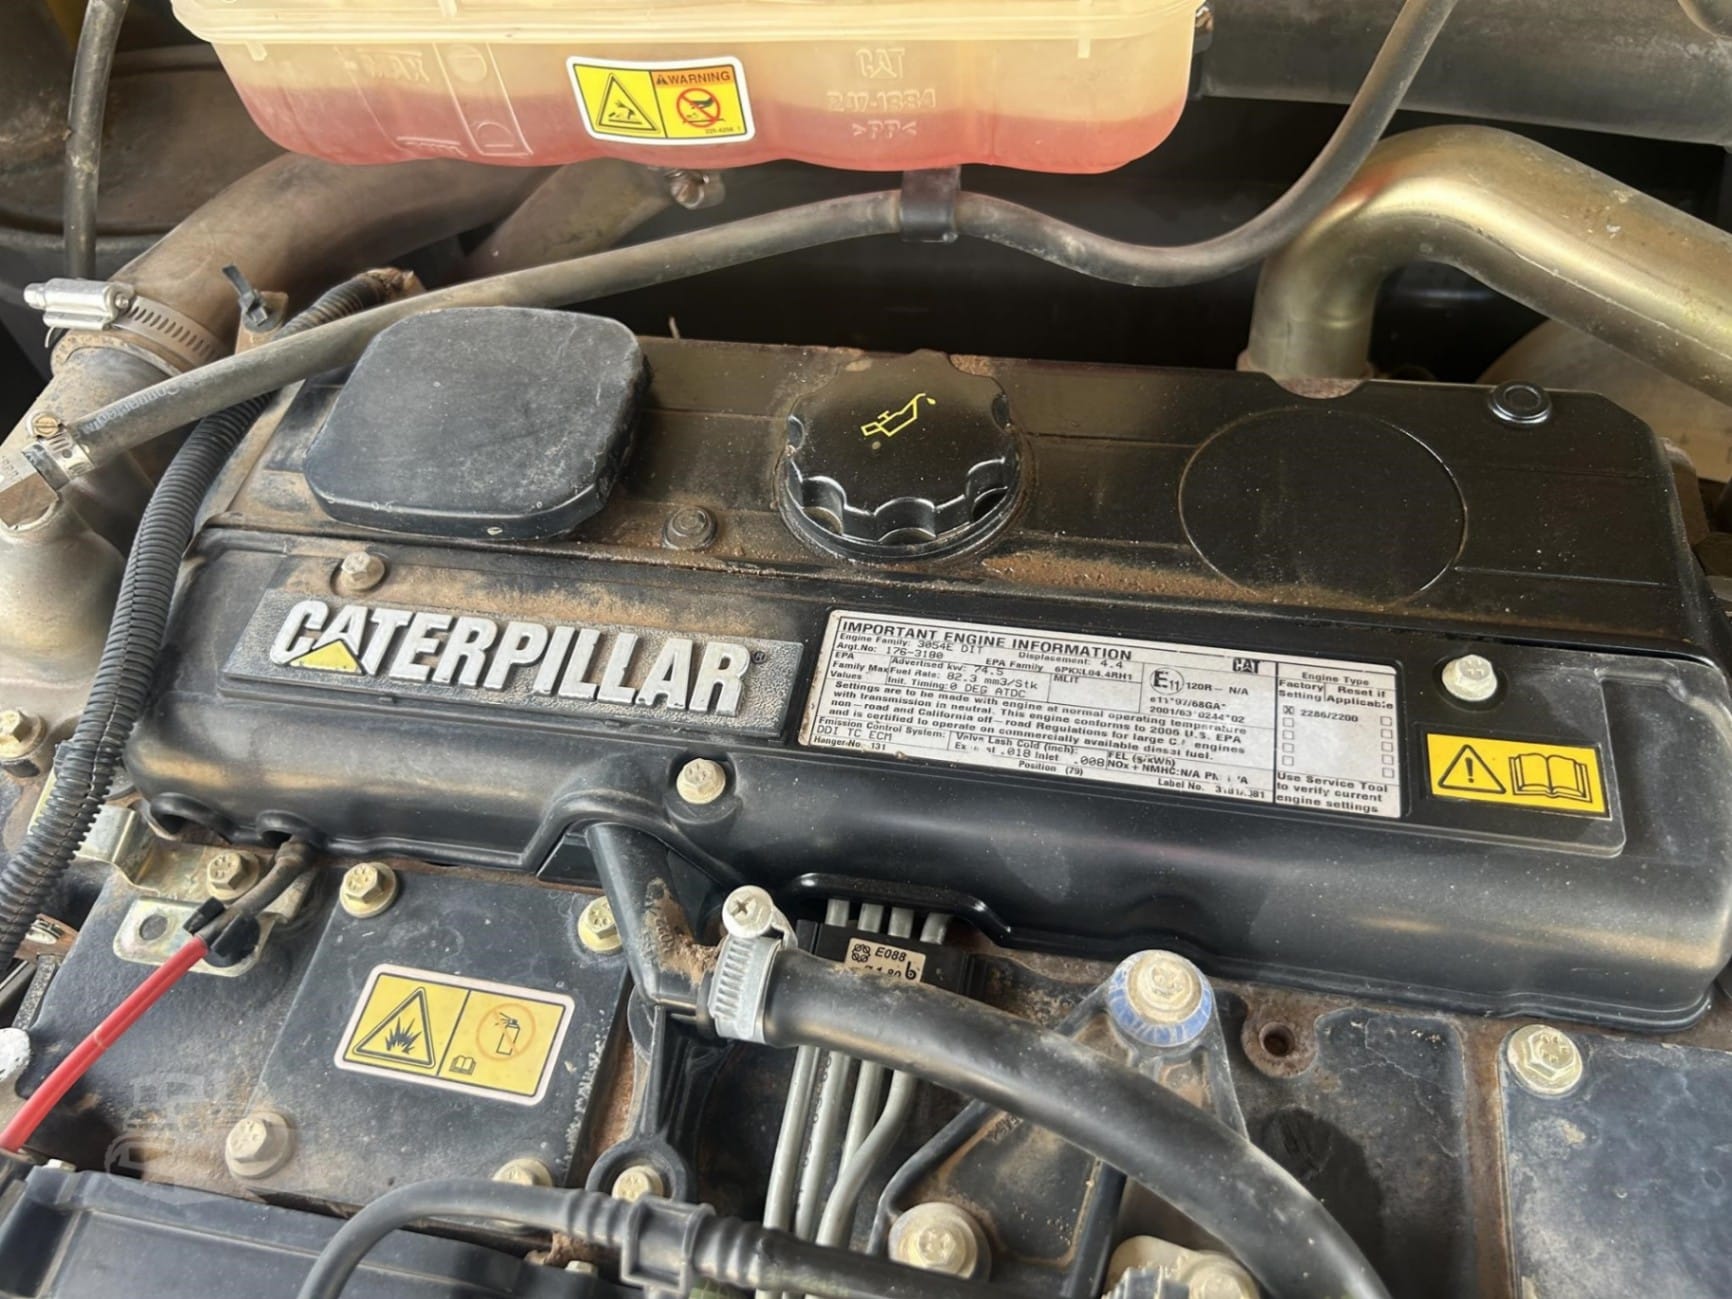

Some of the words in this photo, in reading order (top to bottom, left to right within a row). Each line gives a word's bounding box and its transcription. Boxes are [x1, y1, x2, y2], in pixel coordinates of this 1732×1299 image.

[667, 71, 731, 85] WARNING
[839, 632, 873, 643] Engine
[960, 644, 985, 655] DIT
[842, 621, 938, 641] IMPORTANT
[943, 631, 1006, 649] ENGINE
[1012, 638, 1132, 662] INFORMATION
[269, 600, 752, 717] CATERPILLAR
[834, 651, 854, 660] EPA
[891, 656, 944, 669] Advertised
[832, 660, 866, 672] Family
[867, 664, 889, 674] Max
[889, 666, 912, 676] Fuel
[985, 658, 1006, 667] EPA
[1009, 660, 1044, 673] Family
[1100, 659, 1123, 670] 4.4
[1232, 657, 1261, 674] CAT
[830, 670, 862, 680] Values
[1053, 674, 1080, 684] MLIT
[1301, 671, 1339, 683] Engine
[1343, 676, 1370, 687] Type
[1278, 679, 1325, 693] Factory
[1337, 685, 1373, 697] Reset
[1377, 690, 1386, 698] if
[1278, 689, 1322, 702] Setting
[835, 680, 880, 693] Settings
[883, 687, 902, 695] are
[905, 688, 917, 697] to
[920, 690, 934, 698] be
[938, 693, 970, 702] made
[974, 697, 998, 706] with
[1001, 700, 1043, 711] engine
[1047, 705, 1059, 713] at
[1061, 707, 1104, 718] normal
[1108, 713, 1166, 727] operating
[1170, 719, 1247, 735] temperature
[833, 690, 857, 699] with
[860, 692, 932, 708] transmission
[935, 701, 947, 709] in
[1000, 708, 1025, 718] This
[1029, 713, 1070, 724] engine
[1073, 718, 1131, 731] conforms
[1134, 724, 1146, 732] to
[1215, 733, 1242, 744] EPA
[866, 721, 903, 733] Control
[893, 706, 914, 715] and
[918, 708, 974, 722] California
[1035, 721, 1108, 738] Regulations
[1111, 731, 1129, 740] for
[1132, 733, 1165, 745] large
[1194, 742, 1245, 754] engines
[828, 709, 850, 717] and
[852, 710, 863, 718] is
[866, 712, 914, 724] certified
[917, 717, 929, 726] to
[931, 720, 976, 732] operate
[980, 726, 995, 734] on
[998, 728, 1080, 745] commercially
[1083, 738, 1139, 751] available
[1185, 749, 1213, 760] fuel.
[848, 727, 862, 738] TC
[868, 730, 893, 742] ECM
[1016, 739, 1040, 750] Cold
[1034, 751, 1059, 762] Inlet
[1018, 760, 1057, 772] Position
[1064, 765, 1084, 777] (79)
[1107, 759, 1129, 769] NOx
[1157, 778, 1184, 789] Label
[1277, 771, 1301, 782] Use
[1305, 775, 1355, 789] Service
[1359, 781, 1388, 793] Tool
[1276, 781, 1289, 791] to
[1293, 785, 1330, 797] verify
[1334, 790, 1382, 803] current
[1276, 794, 1321, 806] engine
[1325, 800, 1379, 814] settings
[874, 946, 907, 962] E088
